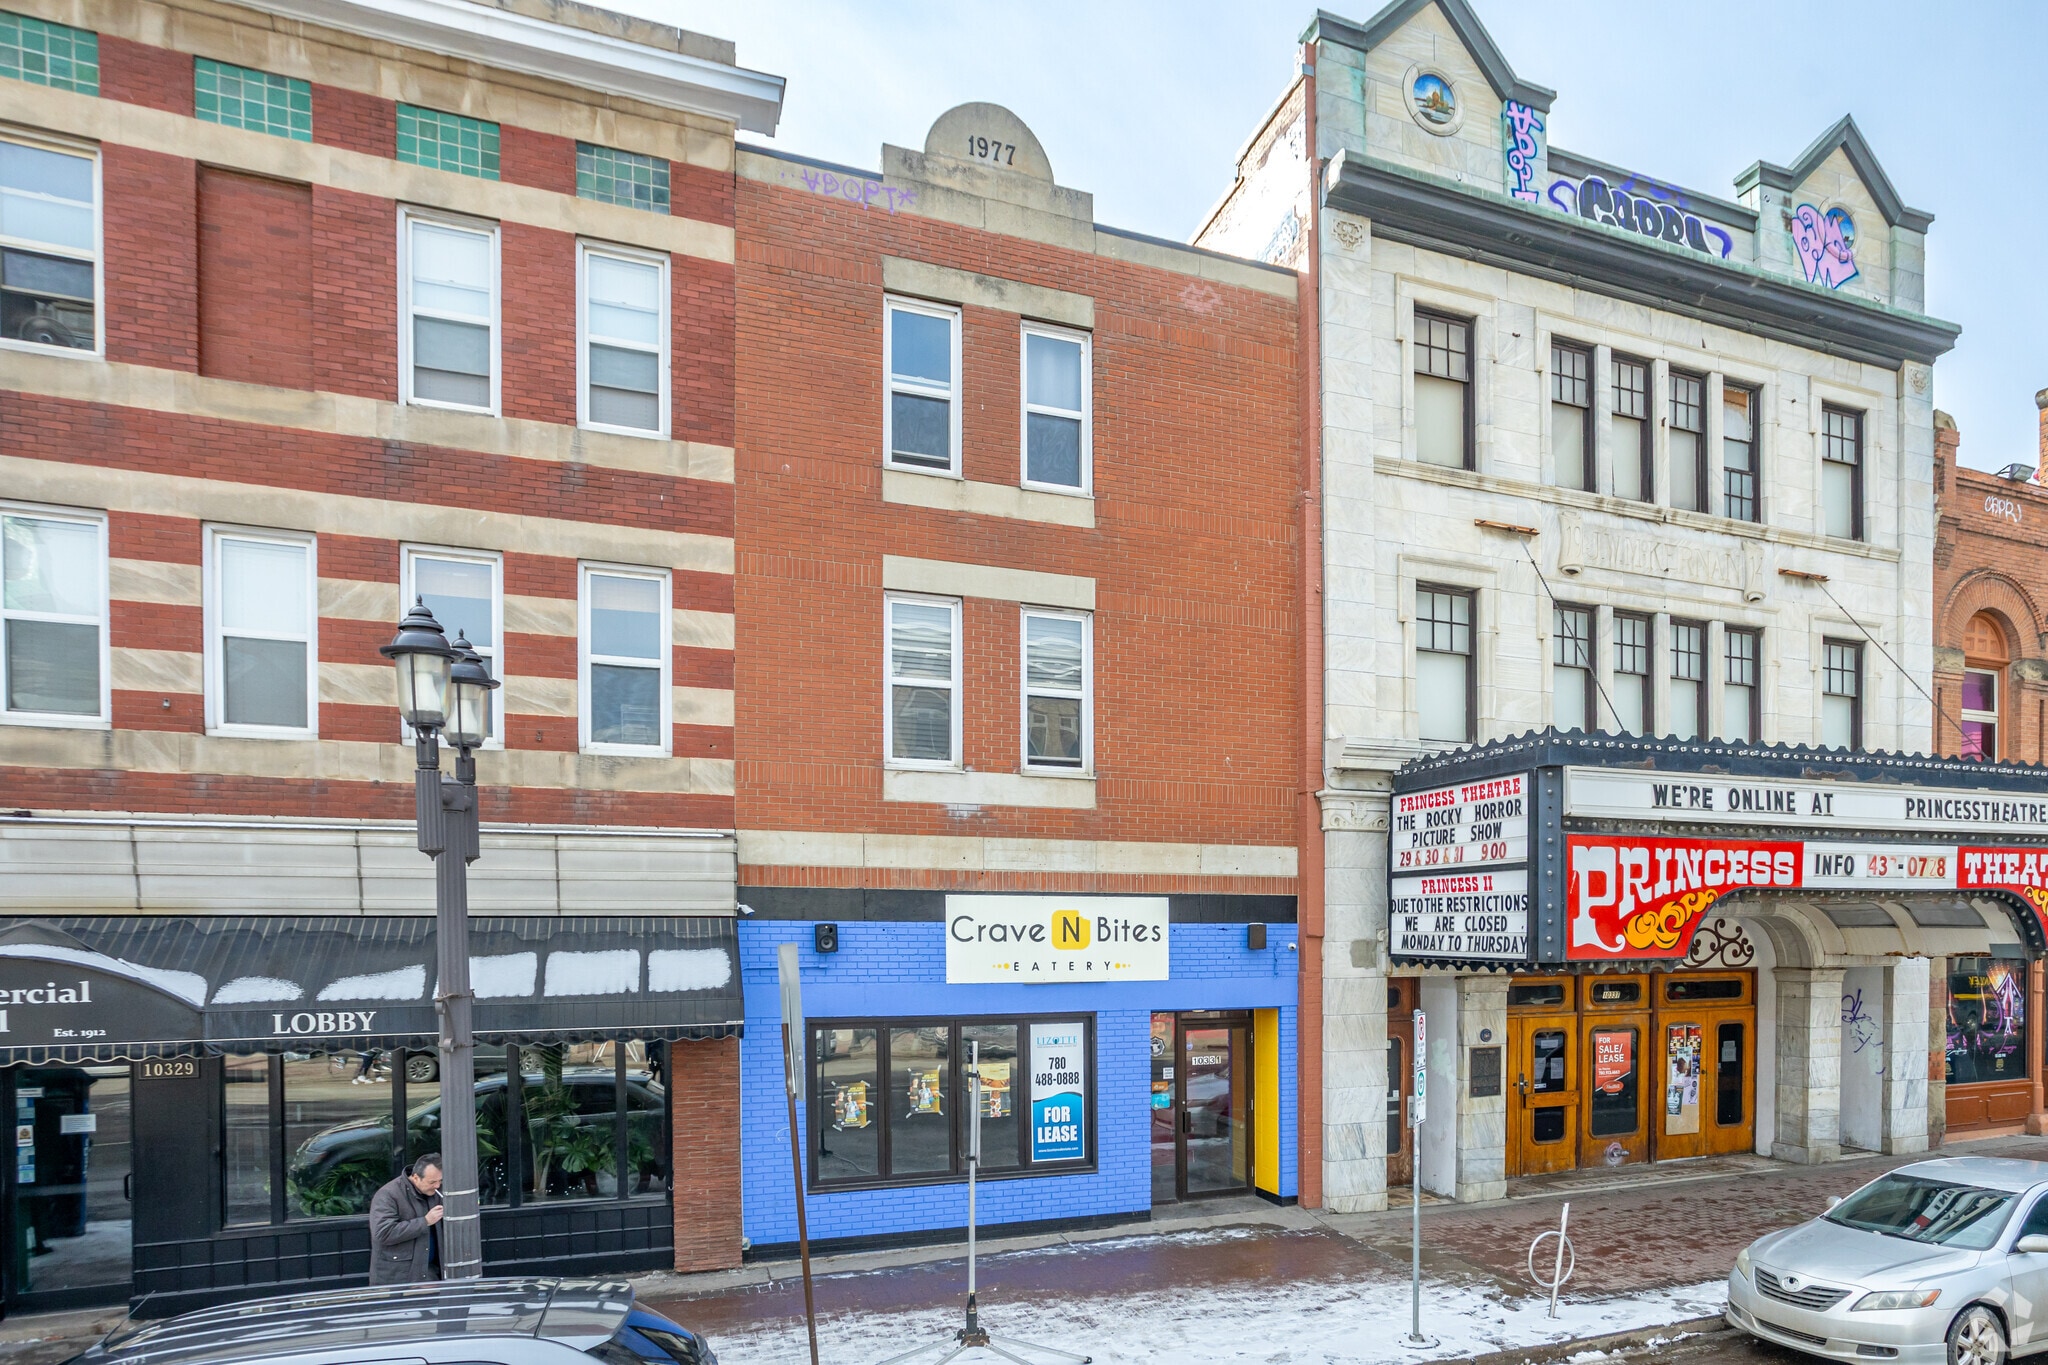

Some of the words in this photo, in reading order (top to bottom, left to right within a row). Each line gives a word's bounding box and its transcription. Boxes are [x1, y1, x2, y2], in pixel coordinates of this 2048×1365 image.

[968, 134, 1016, 166] 1977
[1399, 789, 1456, 813] PRINCESS
[1461, 777, 1521, 803] THEATRE
[1652, 783, 1714, 810] WE'RE
[1728, 787, 1797, 814] ONLINE
[1811, 793, 1834, 814] AT
[1906, 797, 2048, 823] PRINCESSTHEATRE
[1397, 814, 1416, 832] THE
[1426, 807, 1462, 829] ROCKY
[1474, 798, 1522, 823] HORROR
[1412, 828, 1456, 849] PICTURE
[1470, 821, 1503, 842] SHOW
[1400, 851, 1412, 867] 29
[1425, 848, 1439, 865] 30
[1453, 846, 1464, 863] 31
[1481, 841, 1507, 861] 900
[1815, 853, 1855, 876] INFO
[1421, 876, 1479, 894] PRINCESS
[1482, 875, 1493, 891] II
[1391, 898, 1409, 914] DUE
[1410, 898, 1424, 914] TO
[1424, 897, 1444, 914] THE
[1446, 894, 1528, 912] RESTRICTIONS
[1572, 845, 1795, 953] PRINCESS
[951, 915, 1046, 943] Crave
[1062, 916, 1080, 943] N
[1097, 916, 1161, 942] Bites
[1405, 916, 1418, 931] WE
[1434, 916, 1455, 931] ARE
[1464, 915, 1507, 932] CLOSED
[1401, 934, 1444, 950] MONDAY
[1448, 935, 1462, 950] TO
[1467, 935, 1528, 954] THURSDAY
[1013, 961, 1111, 972] EATERY
[272, 1011, 377, 1034] LOBBY
[53, 1028, 78, 1037] Est.
[80, 1029, 107, 1038] 1912
[1598, 1036, 1611, 1044] FOR
[1598, 1043, 1624, 1054] SALE/
[1598, 1053, 1625, 1064] LEASE
[144, 1062, 195, 1078] 10329
[1048, 1056, 1066, 1070] 780
[1035, 1071, 1079, 1086] 488-0888
[1044, 1105, 1071, 1123] FOR
[1037, 1124, 1078, 1144] LEASE
